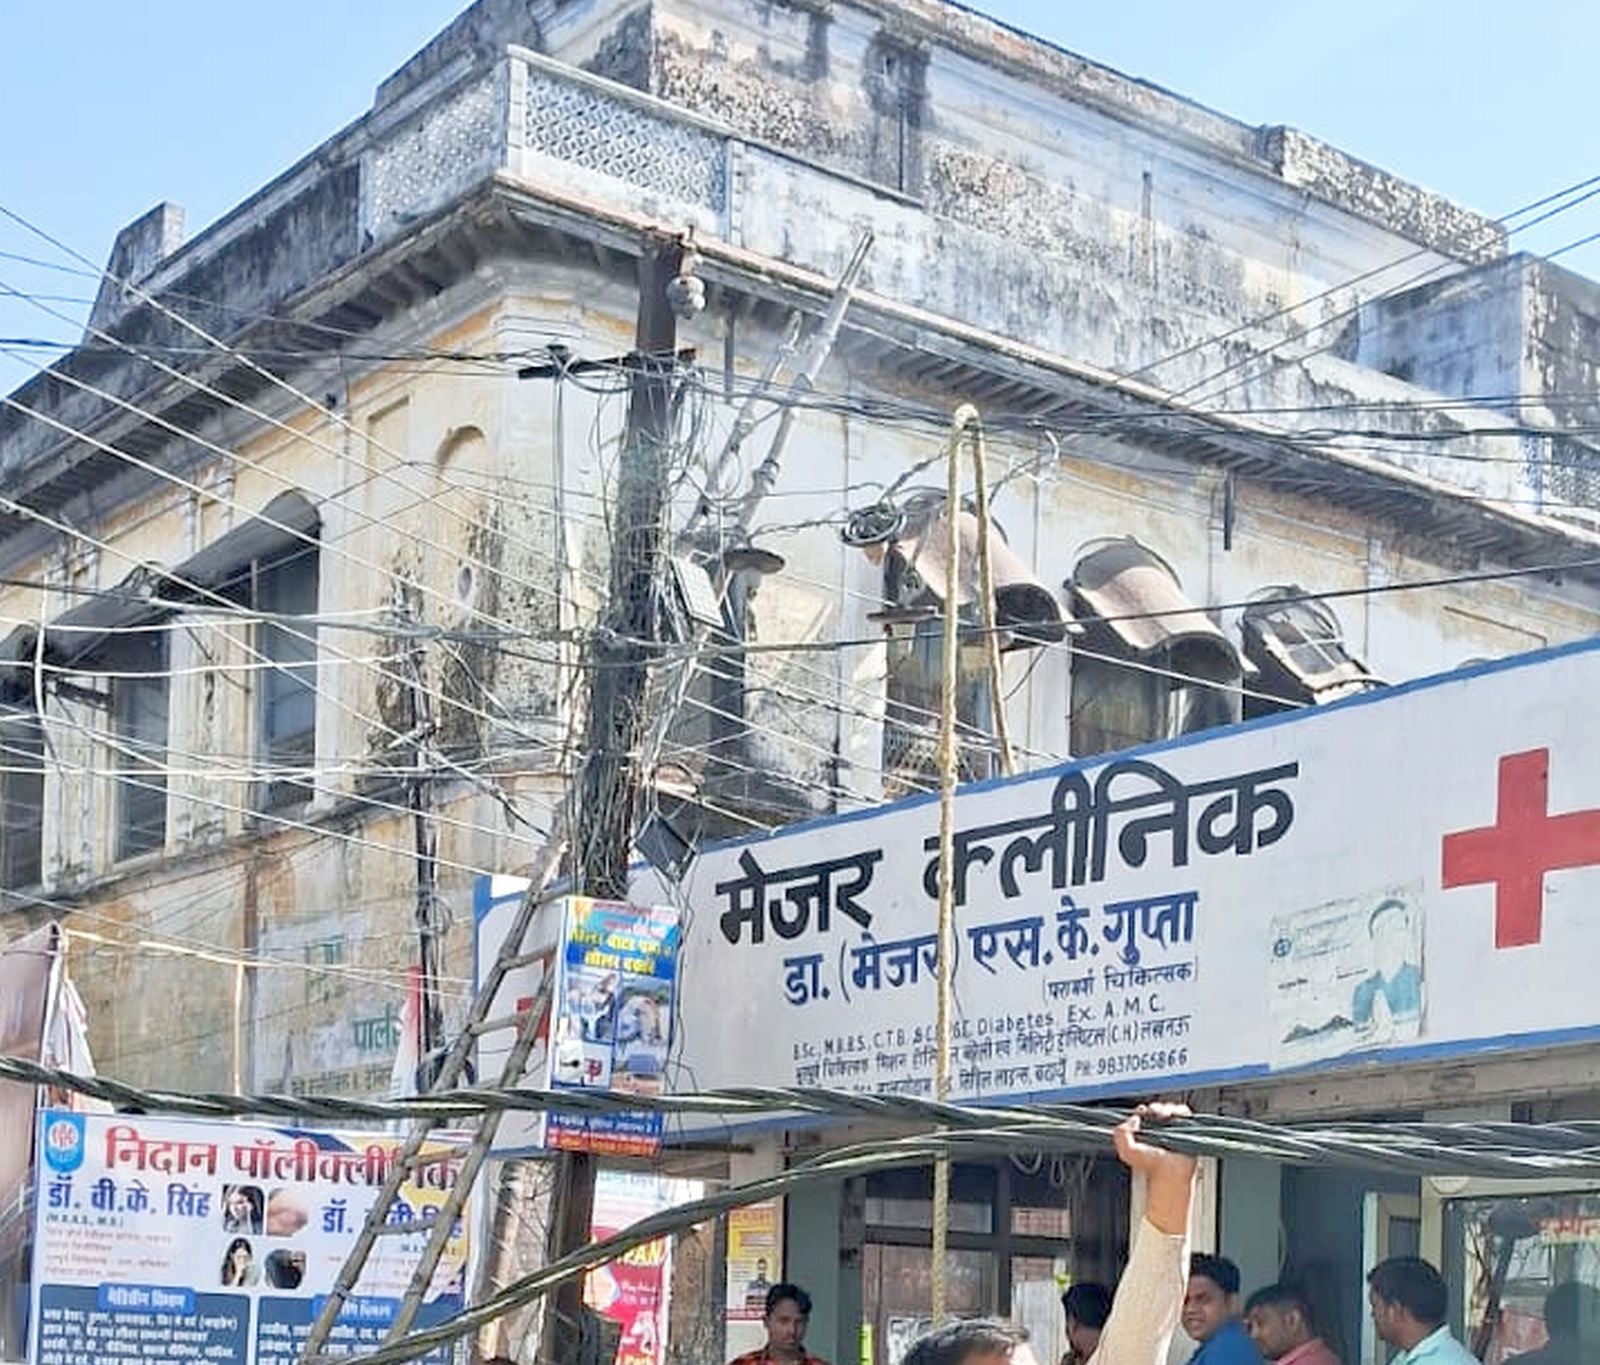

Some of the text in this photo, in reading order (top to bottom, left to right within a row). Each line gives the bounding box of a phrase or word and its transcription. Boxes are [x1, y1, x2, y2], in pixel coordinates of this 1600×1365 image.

[716, 760, 1298, 943] मेजर क्लीनिक
[783, 953, 830, 1006] डा.
[106, 1125, 217, 1176] निदान
[48, 1175, 80, 1209] डॉ.
[167, 1182, 212, 1217] सिंह
